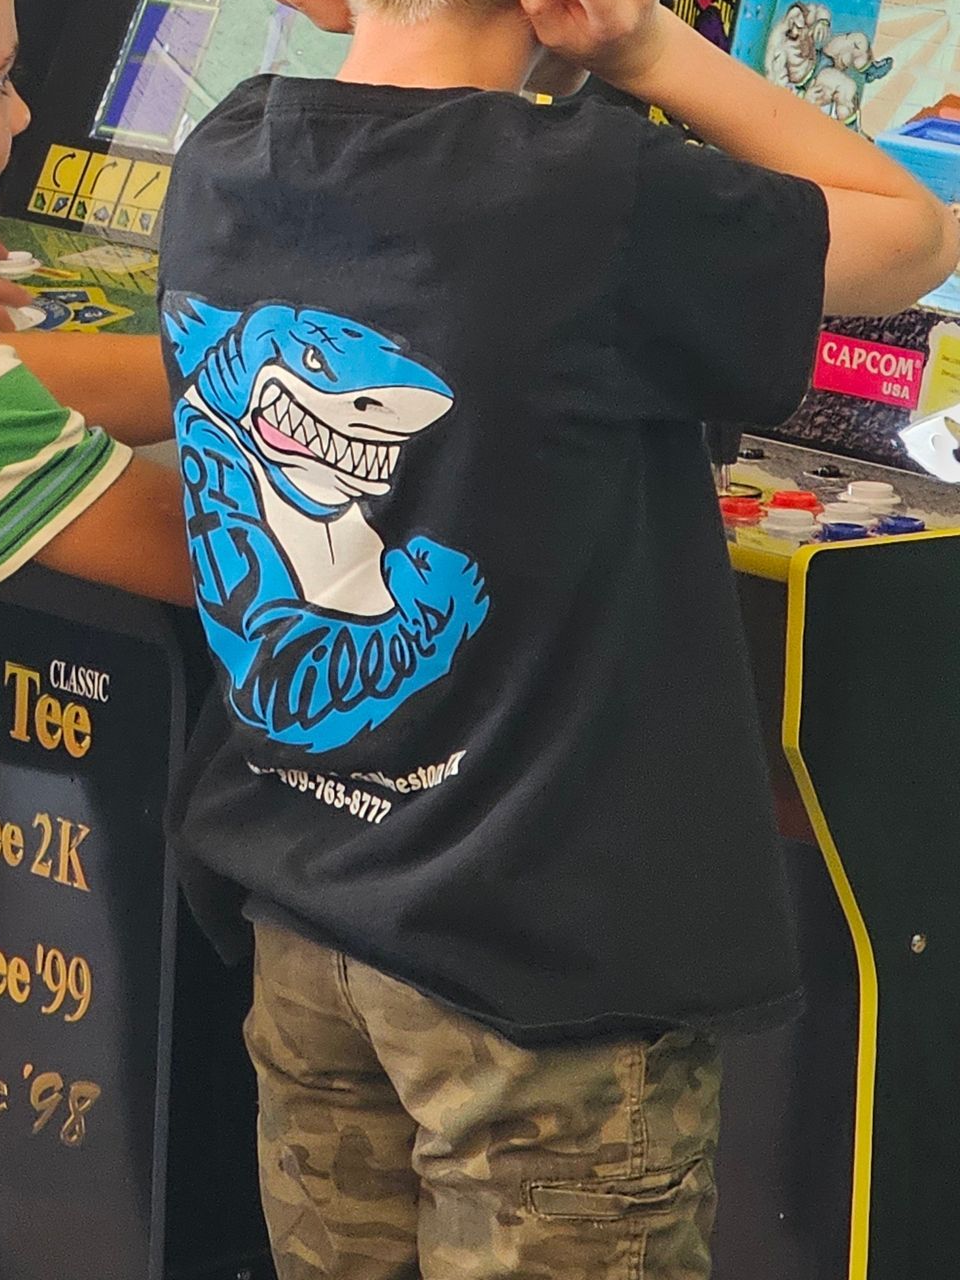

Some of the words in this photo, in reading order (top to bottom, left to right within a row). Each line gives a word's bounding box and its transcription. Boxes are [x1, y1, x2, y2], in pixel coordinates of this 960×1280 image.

[822, 341, 915, 382] CAPCOM
[881, 381, 910, 400] USA
[3, 660, 93, 759] Tee
[49, 659, 110, 703] CLASSIC
[30, 811, 91, 892] 2K
[22, 1062, 102, 1146] '98
